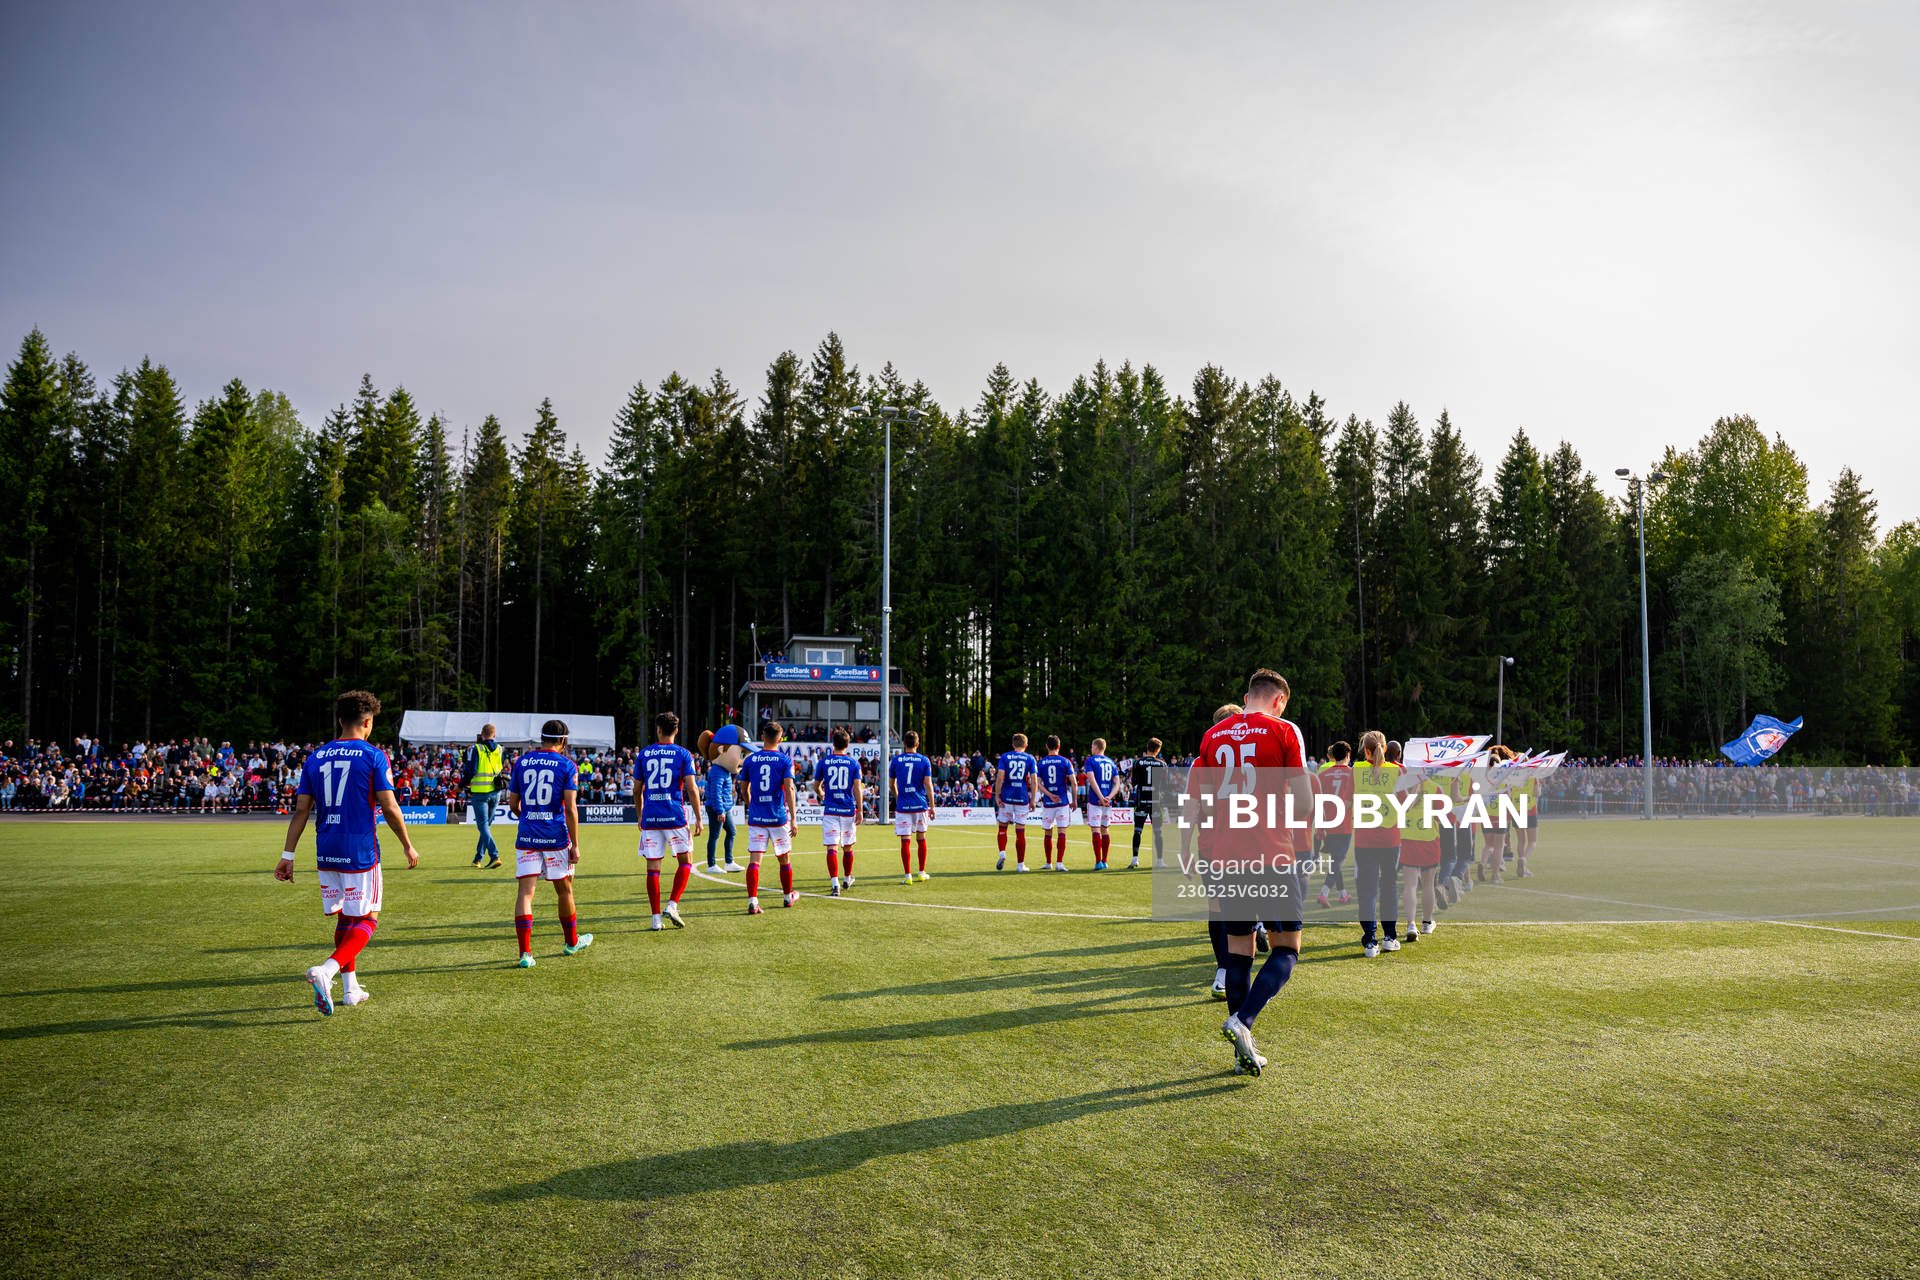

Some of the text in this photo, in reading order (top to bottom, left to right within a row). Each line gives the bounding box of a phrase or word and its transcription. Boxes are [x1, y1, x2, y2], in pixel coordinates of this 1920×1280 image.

[775, 667, 809, 675] SpareBank
[834, 668, 869, 676] SpareBank
[325, 747, 363, 757] fortum
[650, 748, 676, 756] fortum
[528, 758, 558, 767] fortum
[1009, 760, 1026, 780] 23
[646, 758, 674, 789] 25
[760, 764, 771, 791] 3
[827, 766, 849, 790] 20
[905, 762, 914, 784] 7
[1048, 765, 1056, 784] 9
[1100, 763, 1112, 781] 18
[1215, 743, 1257, 799] 25
[1362, 771, 1389, 780] FAR
[319, 761, 351, 807] 17
[523, 769, 554, 806] 26
[1333, 780, 1342, 795] 7
[1362, 777, 1388, 786] PLAY
[404, 811, 435, 819] mino's
[586, 807, 623, 815] NORUM
